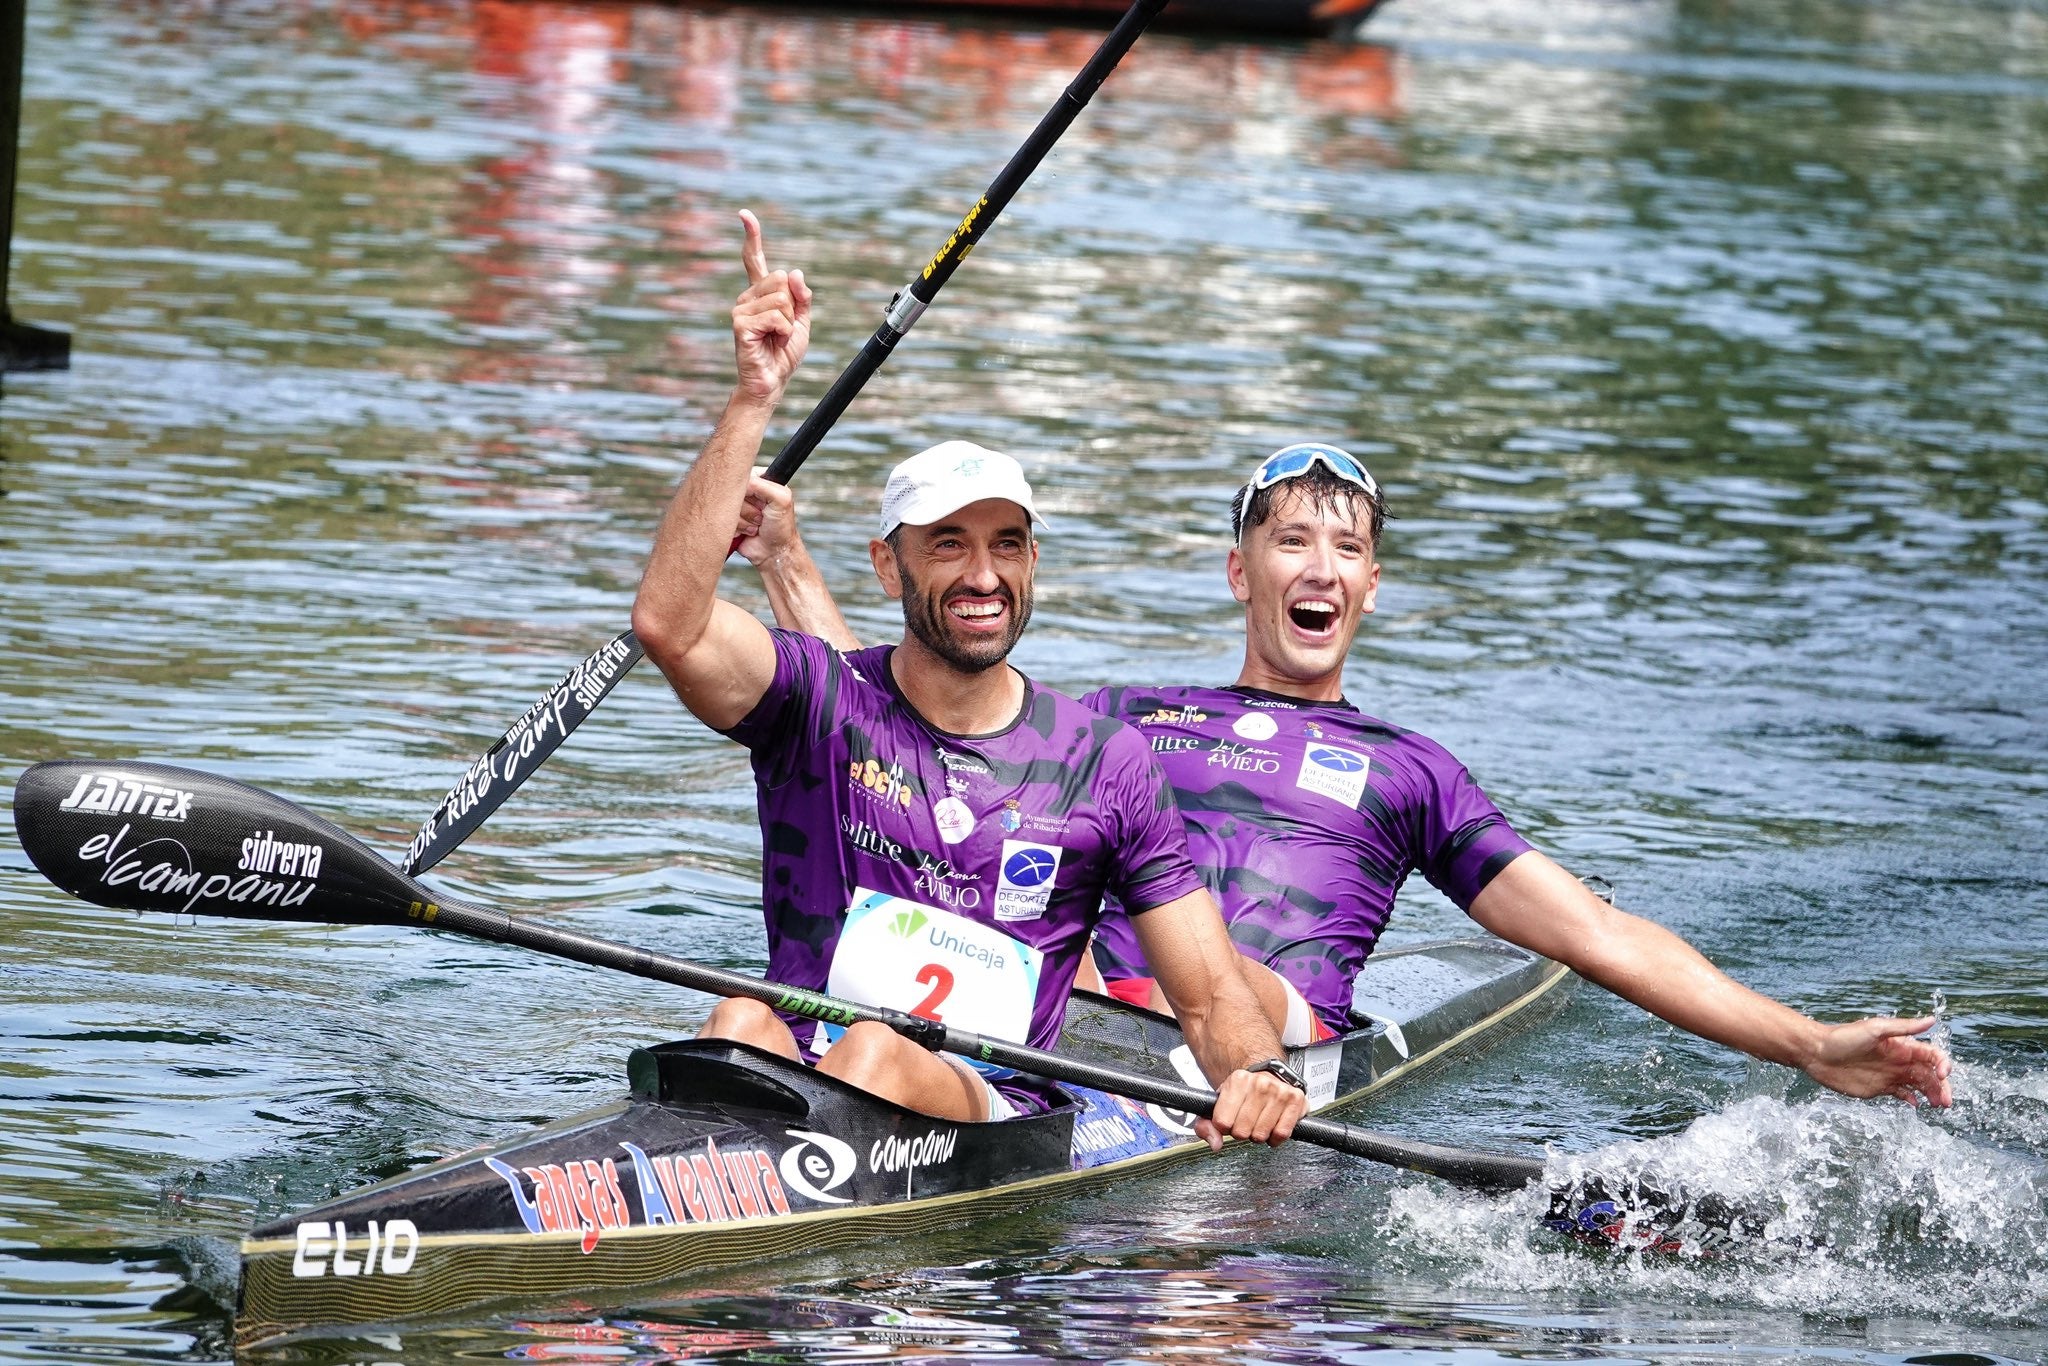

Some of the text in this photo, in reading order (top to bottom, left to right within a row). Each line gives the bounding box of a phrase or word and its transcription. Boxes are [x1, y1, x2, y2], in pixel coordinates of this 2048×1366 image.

[1151, 735, 1200, 751] litre
[1220, 755, 1281, 774] VIEJO
[1033, 822, 1070, 834] Ribadesela
[927, 877, 981, 908] VIEJO
[997, 891, 1047, 905] DEPORTE
[929, 926, 1006, 970] Unicaja
[908, 962, 955, 1023] 2
[618, 1135, 792, 1227] Aventura
